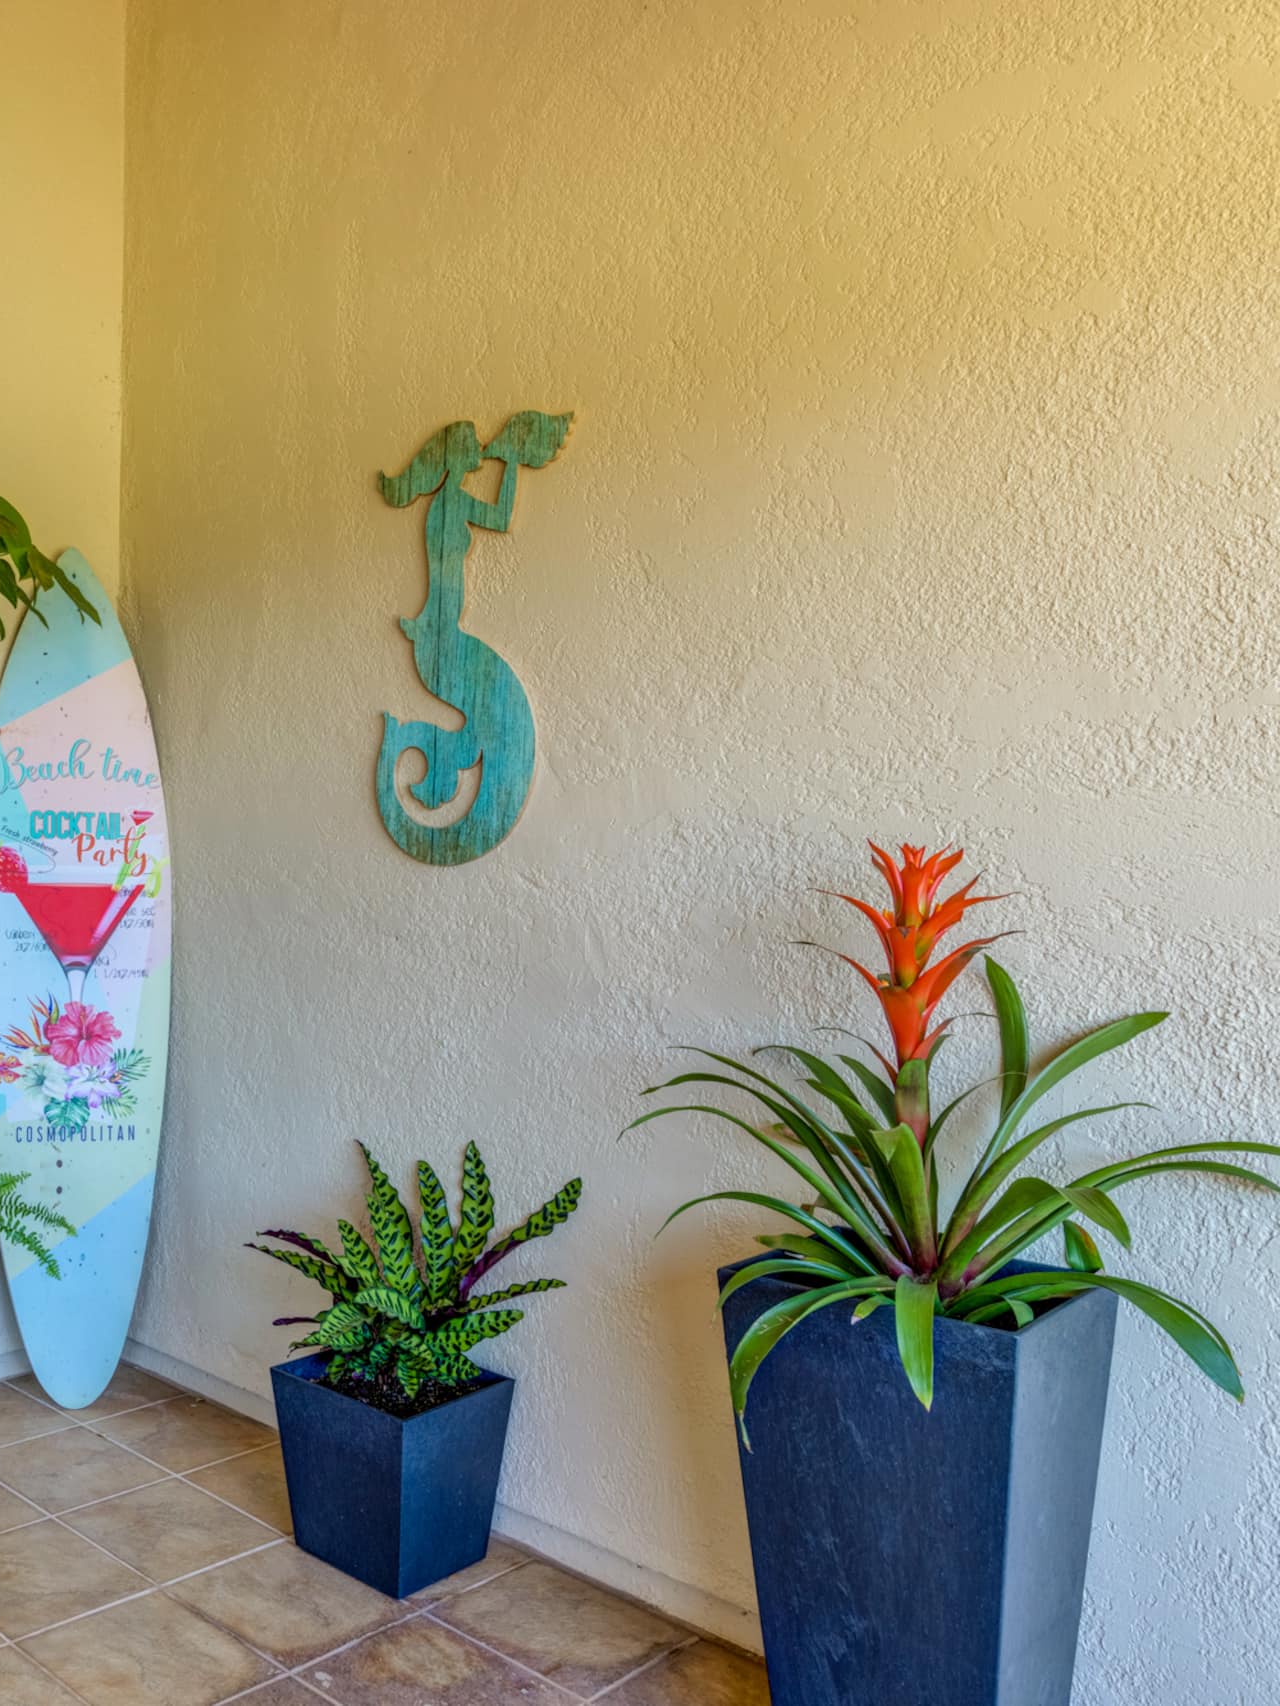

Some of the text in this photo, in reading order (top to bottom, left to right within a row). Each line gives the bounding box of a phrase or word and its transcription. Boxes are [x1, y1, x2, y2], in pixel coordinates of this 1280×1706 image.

[99, 747, 160, 789] time
[30, 810, 125, 840] COCKTAIL
[71, 826, 147, 877] Party
[15, 1125, 135, 1143] COSMOPOLITAN
